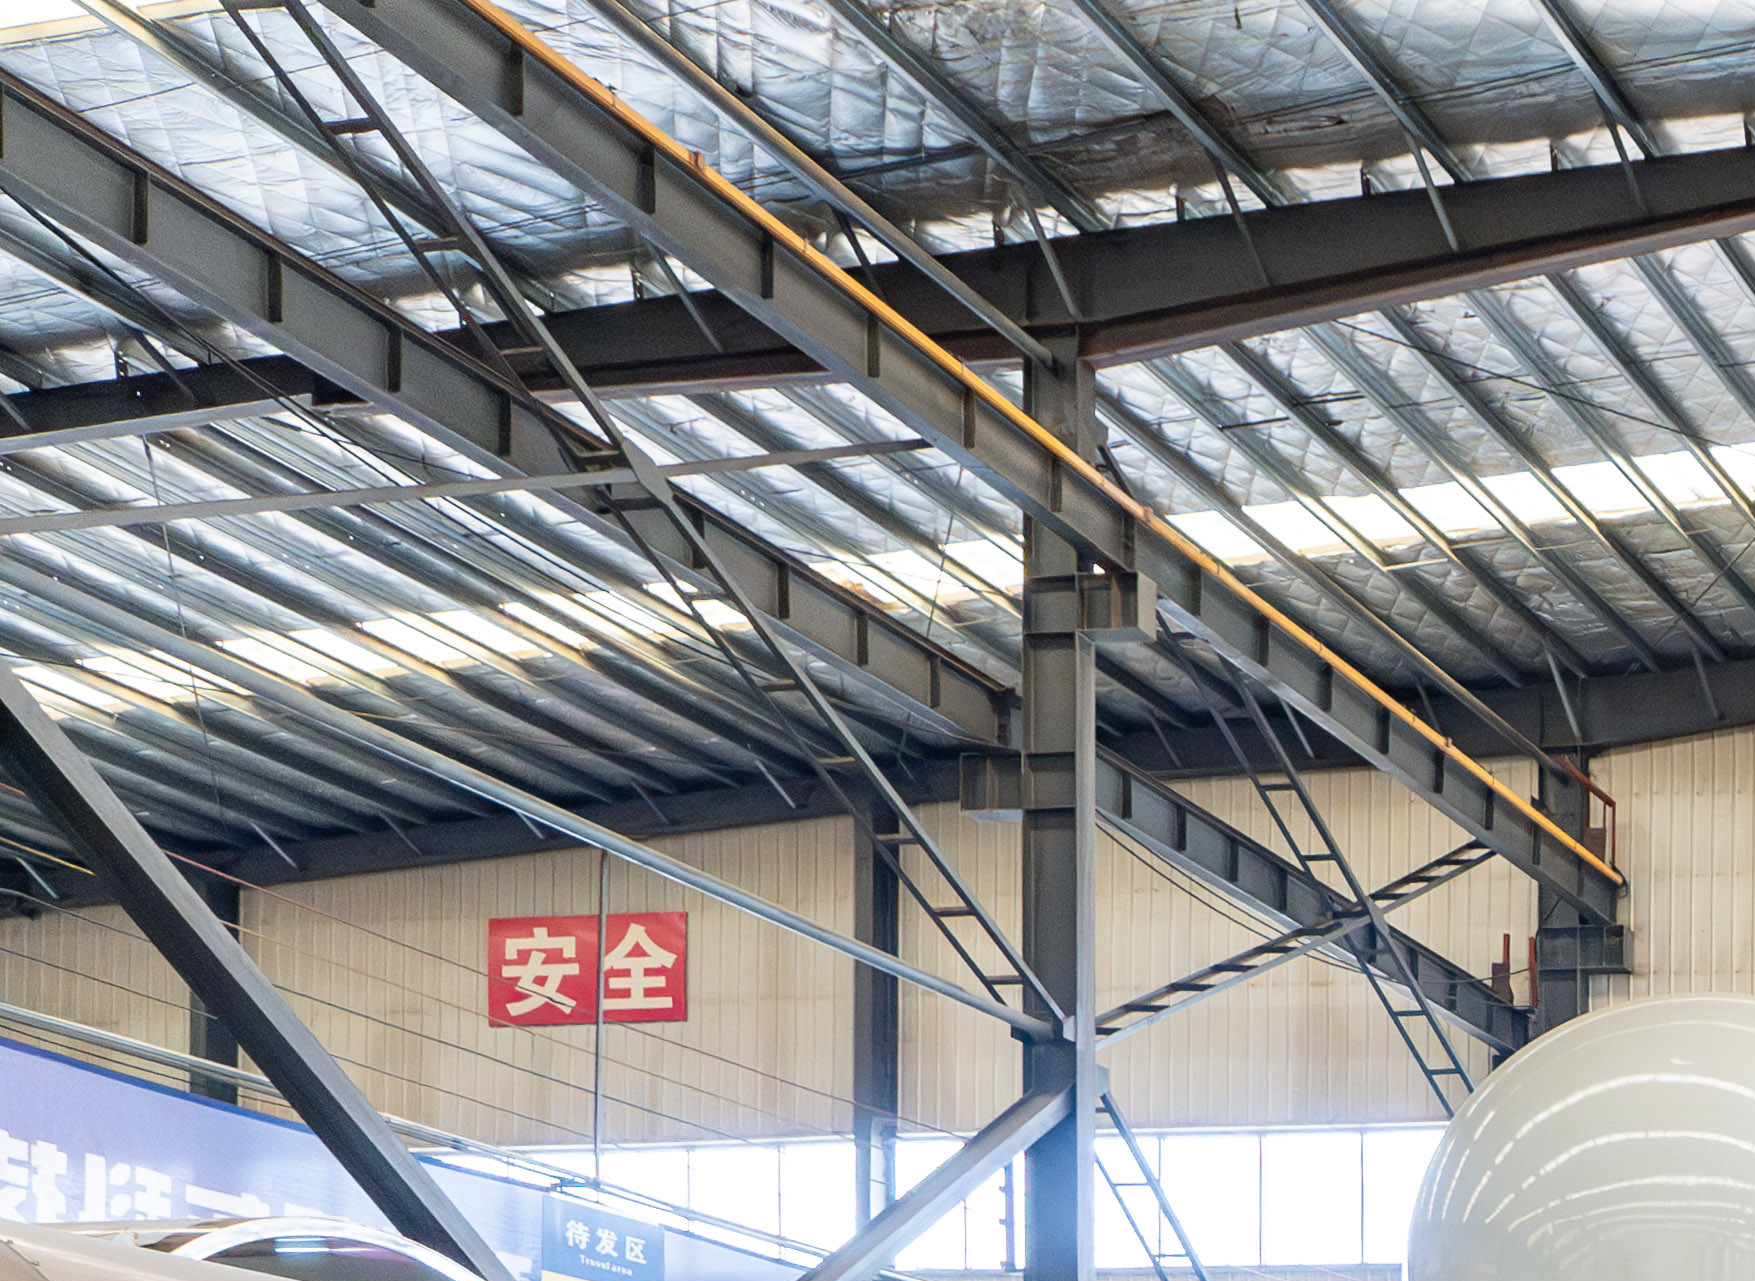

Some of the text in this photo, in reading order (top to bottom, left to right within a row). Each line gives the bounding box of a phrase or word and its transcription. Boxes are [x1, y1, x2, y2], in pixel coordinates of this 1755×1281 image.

[502, 923, 678, 1017] 安全
[565, 1219, 647, 1265] 待发区
[579, 1254, 633, 1278] Travel area
